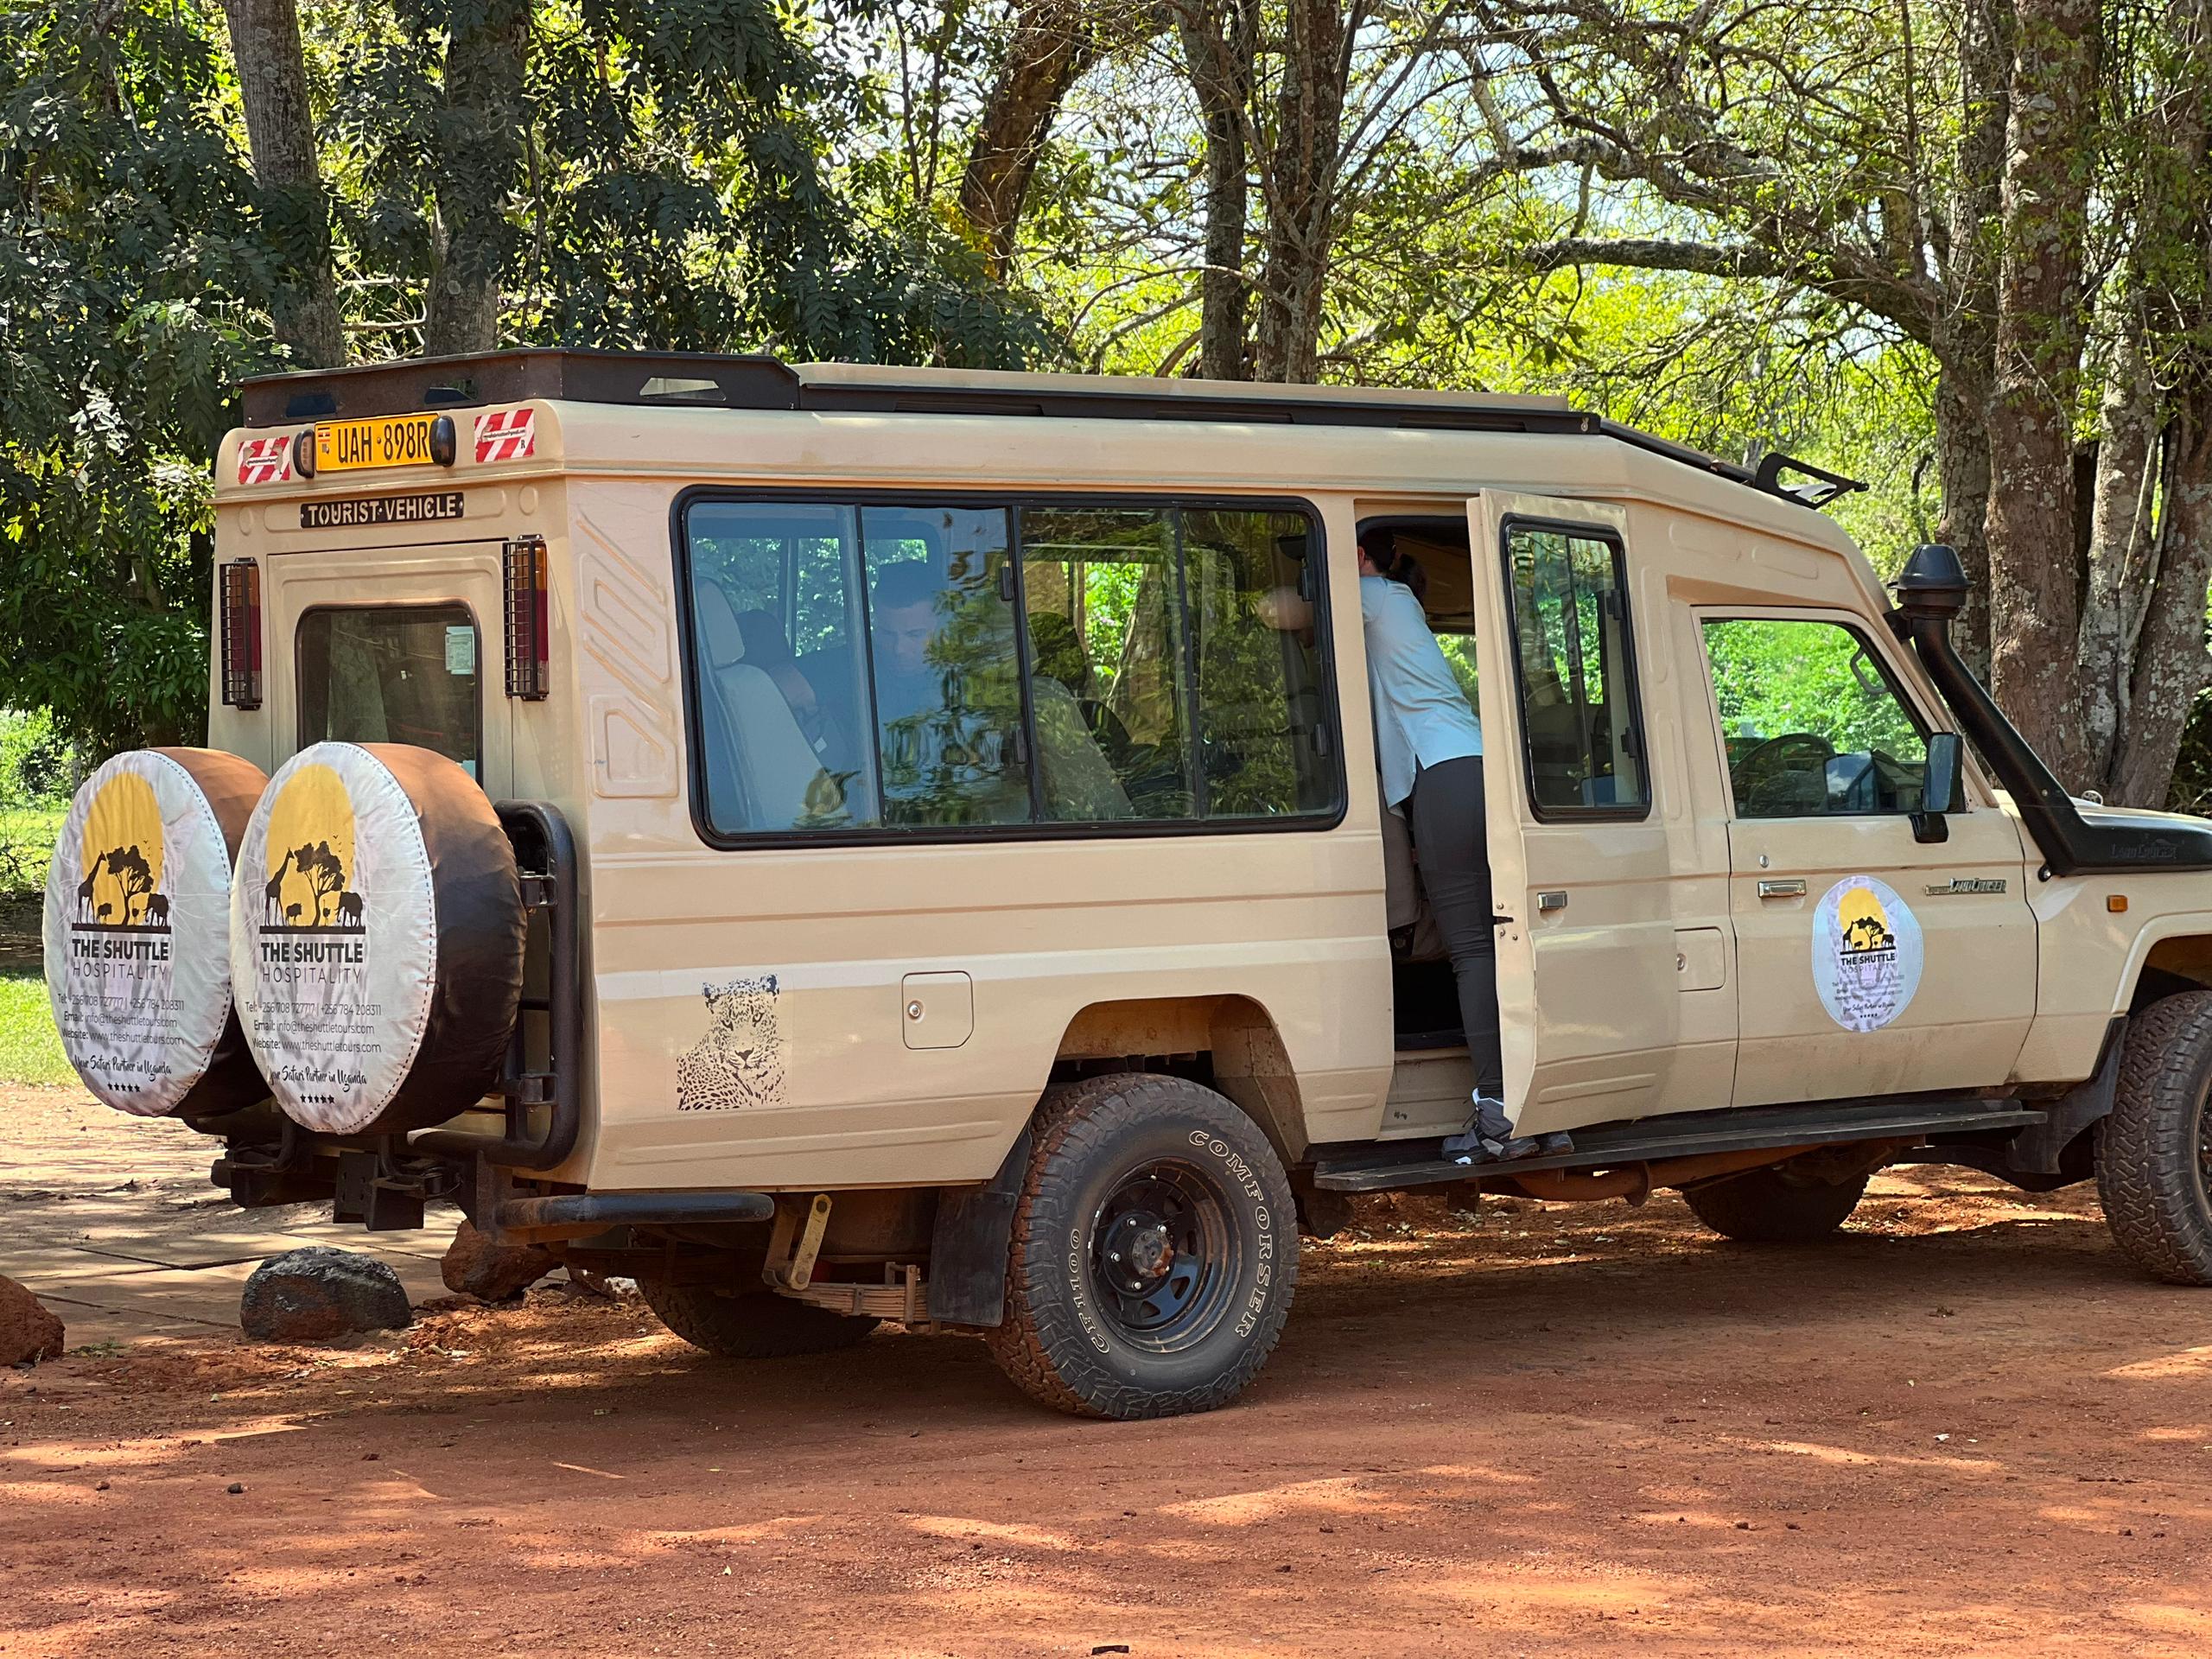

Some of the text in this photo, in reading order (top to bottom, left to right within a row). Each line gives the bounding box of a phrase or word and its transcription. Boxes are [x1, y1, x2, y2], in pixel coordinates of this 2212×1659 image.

[338, 421, 429, 464] UAH 898R
[520, 439, 526, 448] R
[308, 494, 457, 527] TOURIST VEHICLE
[72, 938, 169, 962] THE SHUTTLE
[261, 942, 364, 963] THE SHUTTLE
[1840, 952, 1896, 966] THE SHUTTLE
[73, 962, 168, 981] HOSPITALITY
[262, 966, 363, 984] HOSPITALITY
[147, 998, 160, 1010] 784
[161, 999, 185, 1011] 208311
[245, 1001, 257, 1014] Tel:
[276, 1002, 290, 1014] 708
[321, 1003, 338, 1015] +256
[339, 1003, 354, 1016] 784
[355, 1004, 382, 1017] 208311
[64, 1010, 178, 1027] Email: info@theshuttletours.com
[253, 1019, 375, 1036] Email: info@theshuttletours.com
[61, 1027, 89, 1040] Website:
[251, 1038, 383, 1053] Website: www.theshuttletours.com
[112, 1056, 136, 1073] Partner
[143, 1058, 173, 1082] Uganda
[305, 1065, 327, 1084] Partner
[336, 1068, 368, 1093] Uganda
[1188, 1129, 1274, 1338] COMFORSER
[1068, 1228, 1111, 1355] CF1100
